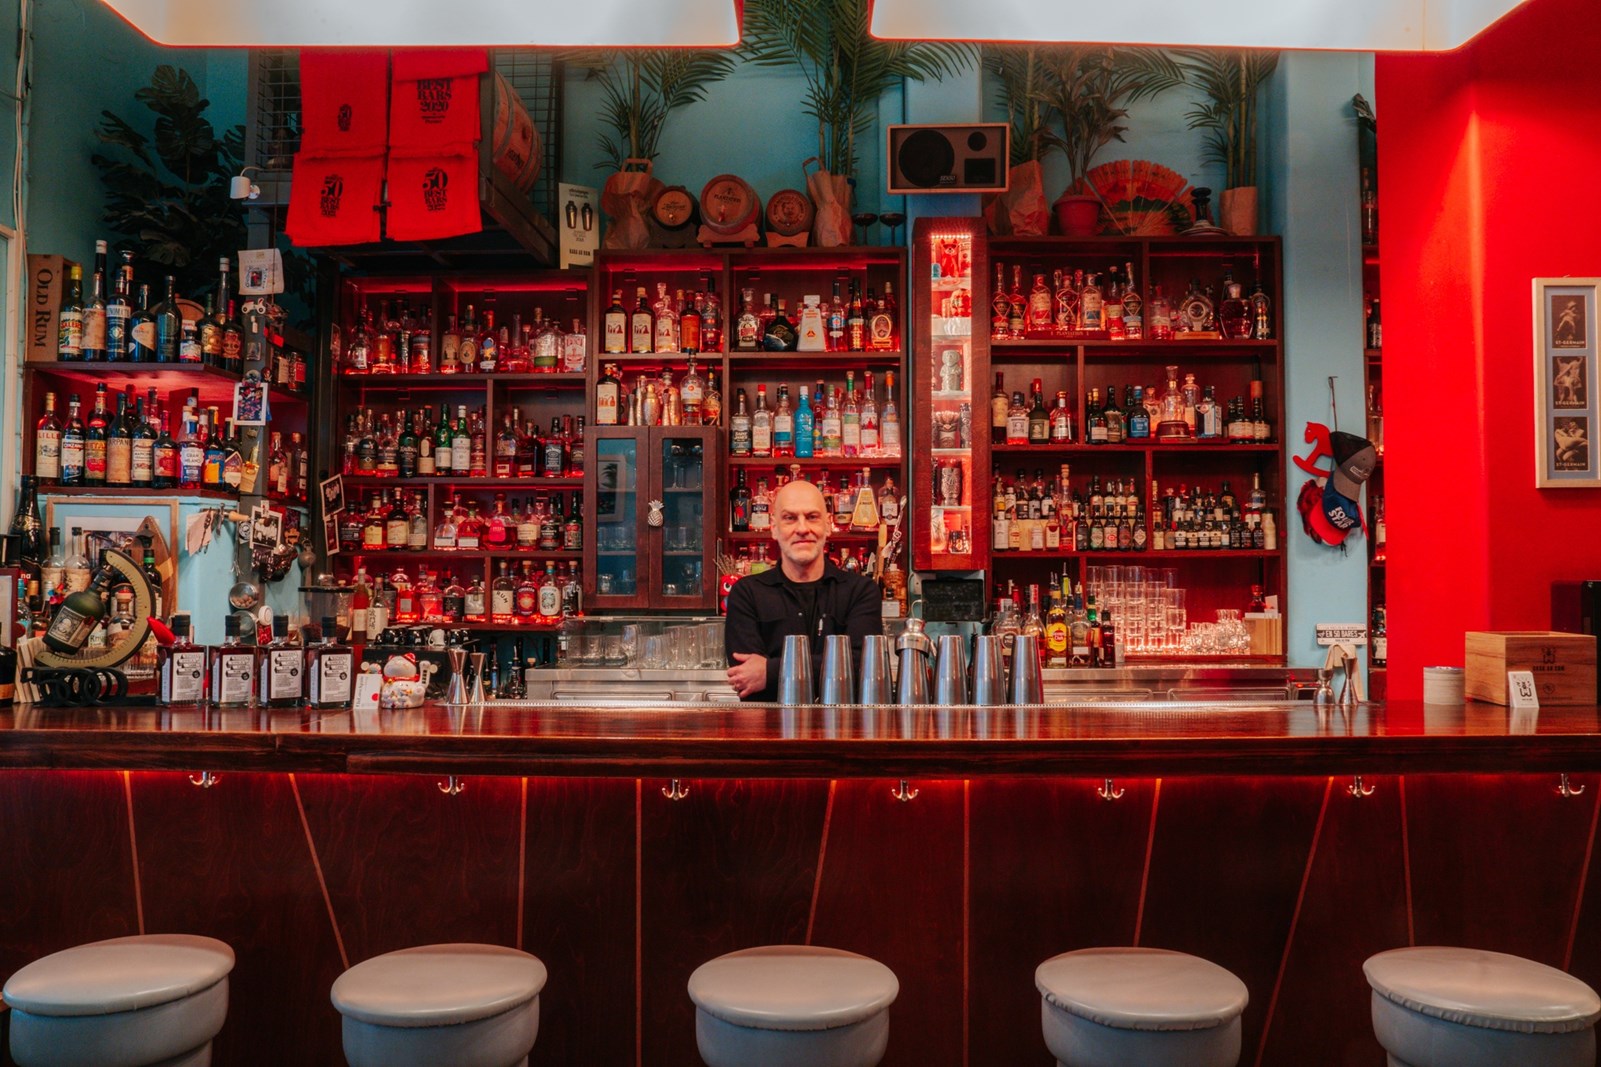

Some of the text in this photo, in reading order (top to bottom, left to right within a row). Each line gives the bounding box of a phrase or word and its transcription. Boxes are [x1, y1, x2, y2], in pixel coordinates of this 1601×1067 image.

[417, 79, 453, 90] BEST
[417, 90, 452, 100] BARS
[420, 101, 449, 112] 2020
[321, 176, 343, 197] 50
[422, 169, 448, 189] 50
[34, 268, 53, 348] OLD RUM
[1328, 509, 1349, 529] STAR
[496, 591, 508, 604] RUM
